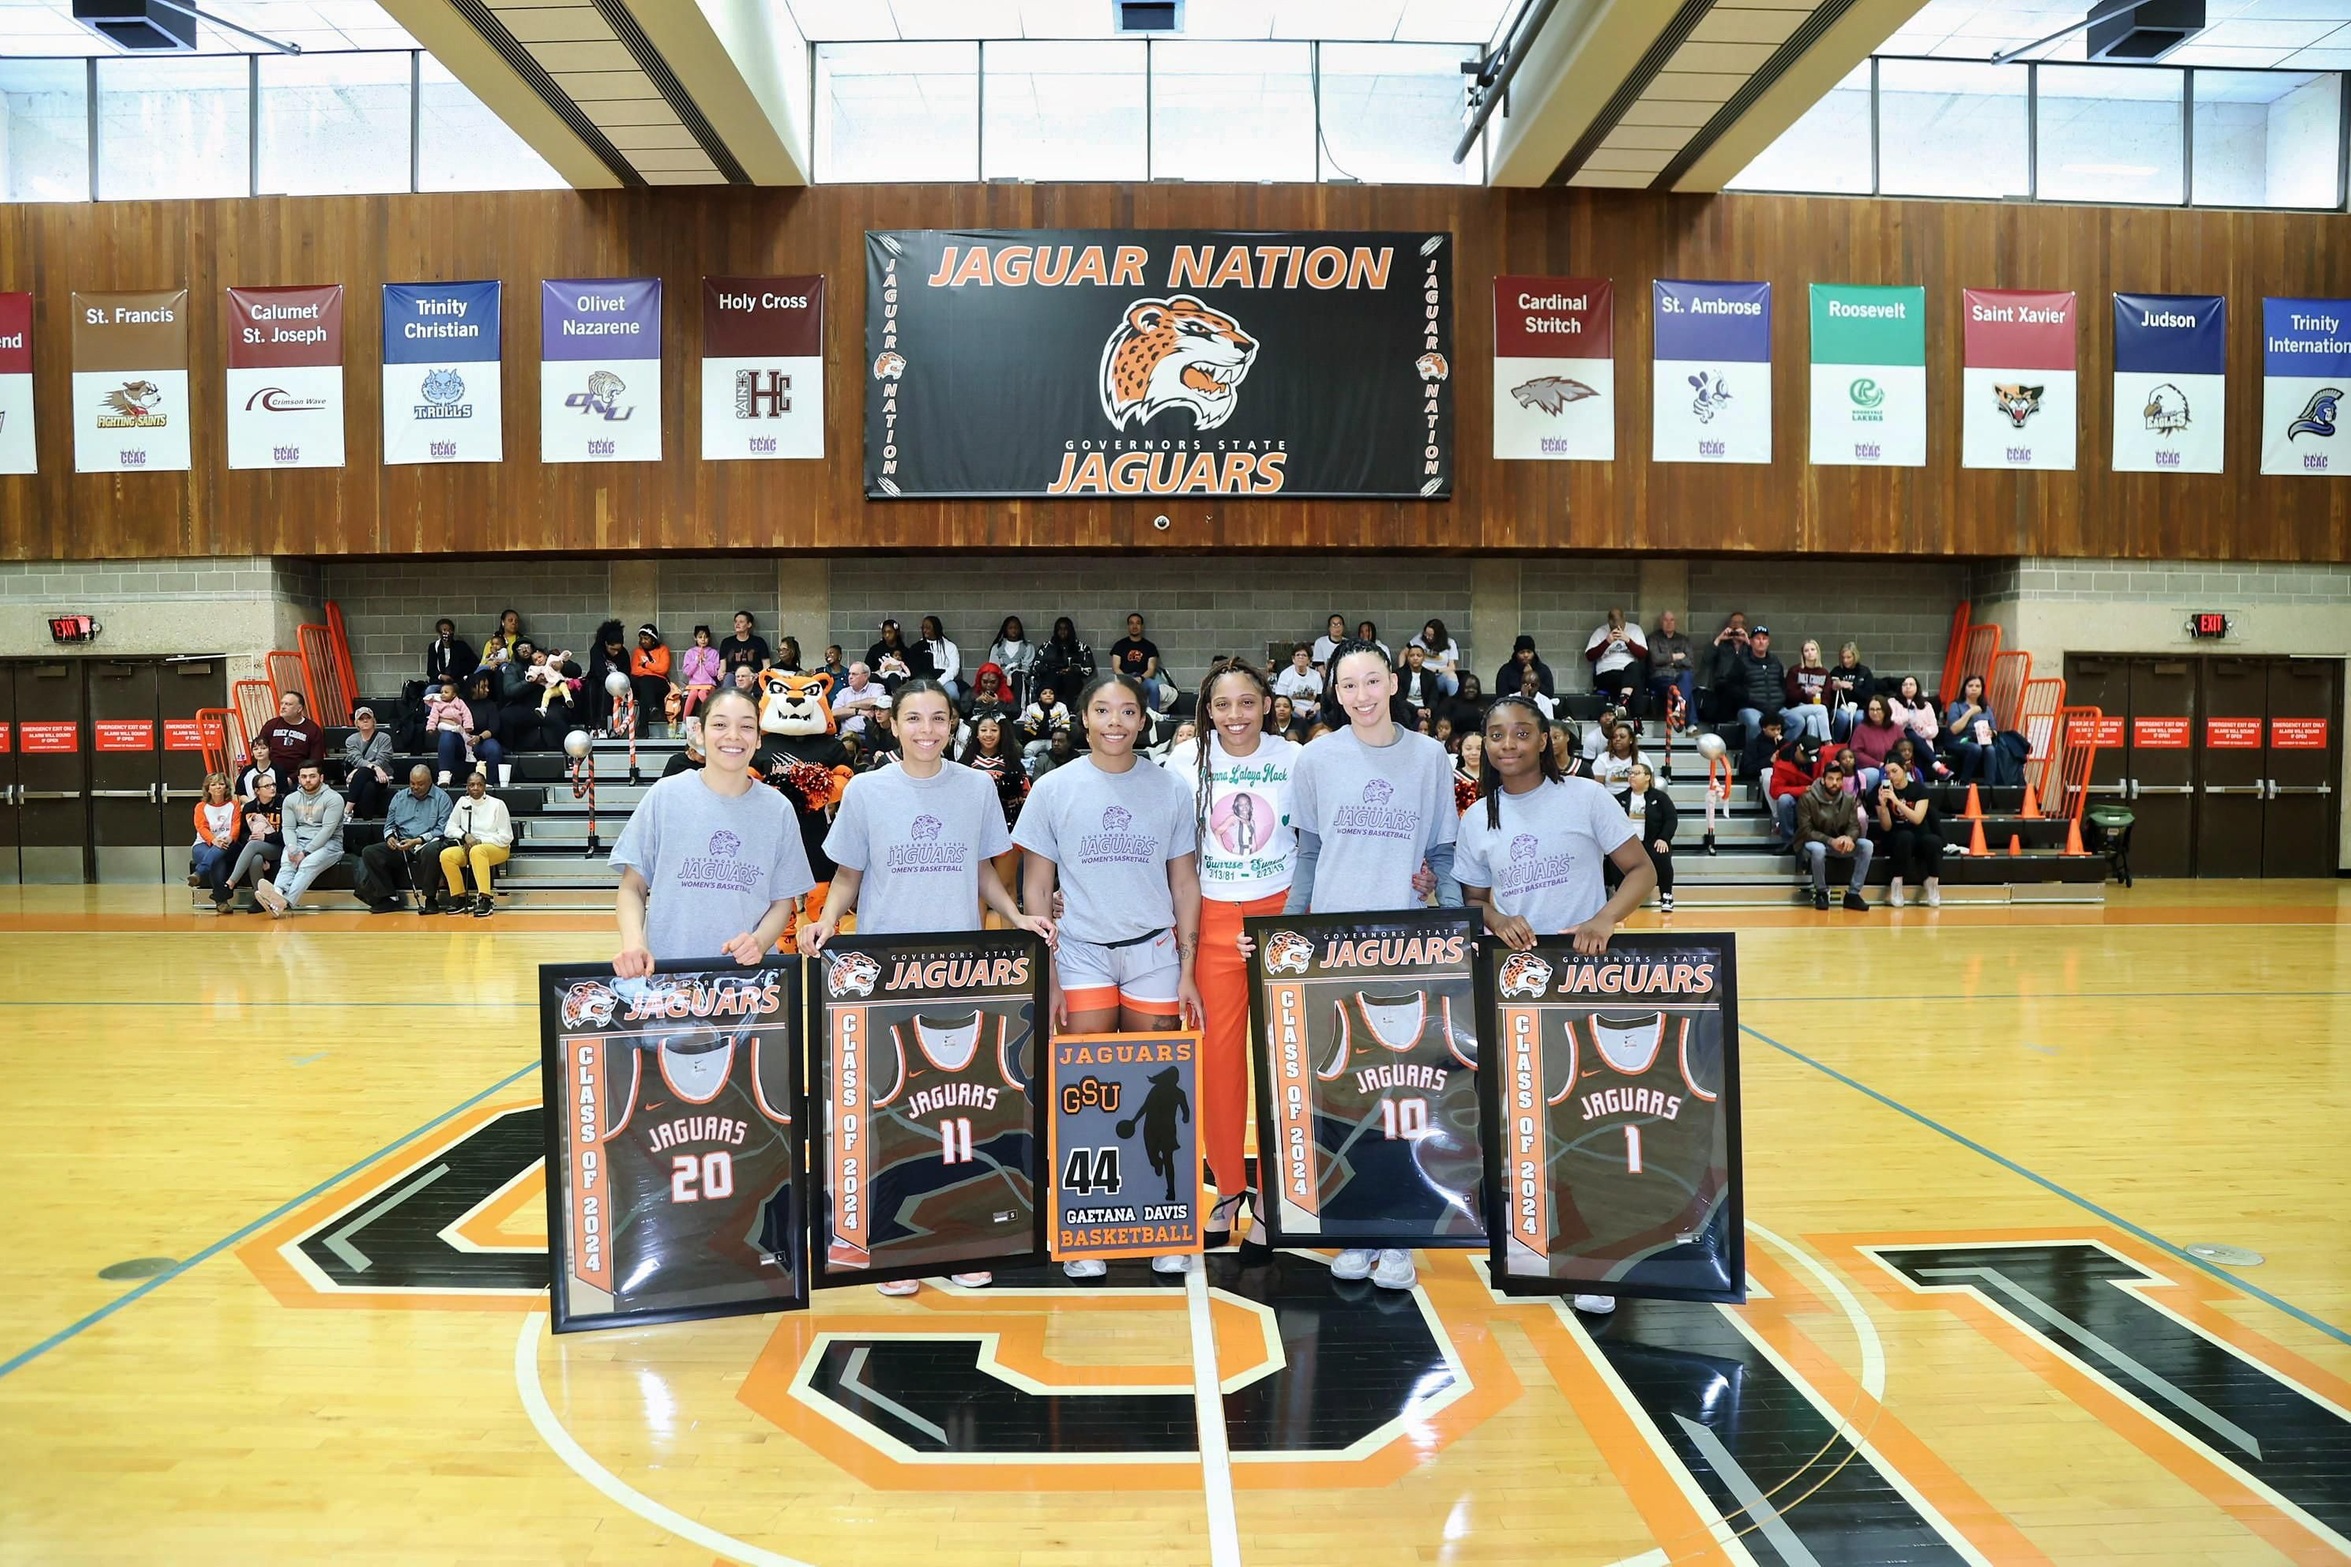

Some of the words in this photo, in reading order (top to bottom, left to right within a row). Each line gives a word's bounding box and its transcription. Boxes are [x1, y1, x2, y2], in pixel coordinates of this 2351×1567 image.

[928, 246, 1149, 287] JAGUAR
[1167, 245, 1394, 290] NATION
[251, 303, 318, 320] Calumet
[416, 299, 467, 317] Trinity
[577, 295, 625, 312] Olivet
[719, 293, 757, 313] Holy
[762, 293, 807, 309] Cross
[883, 259, 897, 349] JAGUAR
[1424, 259, 1439, 349] JAGUAR
[1518, 293, 1587, 311] Cardinal
[1662, 296, 1684, 313] St.
[1690, 298, 1761, 315] Ambrose
[1829, 301, 1905, 319] Roosevelt
[86, 308, 109, 324] St.
[115, 307, 173, 323] Francis
[1972, 305, 2013, 322] Saint
[2019, 306, 2065, 324] Xavier
[2141, 311, 2196, 328] Judson
[2291, 314, 2339, 333] Trinity
[243, 327, 265, 344] St.
[271, 326, 327, 345] Joseph
[404, 323, 479, 339] Christian
[563, 320, 640, 336] Nazarene
[1525, 317, 1581, 334] Stritch
[414, 404, 472, 419] TROLLS
[565, 393, 637, 421] ONU
[97, 415, 136, 428] FIGHTING
[138, 414, 167, 427] SAINTS
[882, 384, 897, 474] NATION
[1424, 384, 1439, 475] NATION
[273, 447, 299, 460] CCAC
[430, 443, 456, 456] CCAC
[588, 441, 614, 454] CCAC
[750, 438, 776, 452] CCAC
[1065, 440, 1201, 451] GOVERNORS
[1219, 440, 1286, 451] STATE
[1542, 439, 1567, 452] CCAC
[1699, 442, 1725, 454] CCAC
[1855, 445, 1881, 457] CCAC
[2007, 448, 2031, 461] CCAC
[120, 452, 146, 464] CCAC
[2156, 452, 2180, 464] CCAC
[2304, 455, 2328, 468] CCAC
[1047, 452, 1287, 494] JAGUARS
[2201, 615, 2222, 632] EXIT
[1334, 810, 1416, 831] JAGUARS
[1368, 829, 1411, 840] BASKETBALL
[887, 847, 964, 866] JAGUARS
[1079, 838, 1155, 856] JAGUARS
[892, 865, 918, 873] OMEN'S
[1082, 856, 1113, 864] WOMEN'S
[678, 861, 759, 885] JAGUARS
[1525, 877, 1569, 893] BASKETBALL
[1324, 931, 1405, 940] GOVERNORS
[891, 952, 973, 960] GOVERNORS
[1320, 937, 1464, 968] JAGUARS
[885, 958, 1030, 990] JAGUARS
[1558, 964, 1714, 993] JAGUARS
[624, 985, 781, 1021] JAGUARS
[1281, 990, 1300, 1078] CLASS
[842, 1014, 858, 1107] CLASS
[1059, 1044, 1192, 1065] JAGUARS
[1515, 1015, 1533, 1109] CLASS
[1356, 1064, 1448, 1095] JAGUARS
[578, 1046, 597, 1143] CLASS
[908, 1083, 999, 1119] JAGUARS
[1062, 1075, 1121, 1114] GSU
[1287, 1086, 1302, 1120] OF
[1581, 1087, 1682, 1121] JAGUARS
[1381, 1098, 1428, 1141] 10
[649, 1116, 747, 1152] JAGUARS
[843, 1114, 858, 1150] OF
[939, 1117, 972, 1165] 11
[1519, 1117, 1534, 1154] OF
[1624, 1124, 1643, 1174] 1
[581, 1151, 598, 1190] OF
[1063, 1146, 1122, 1196] 44
[1290, 1127, 1307, 1195] 2024
[671, 1151, 734, 1203] 20
[843, 1158, 858, 1230] 2024
[1521, 1162, 1537, 1235] 2024
[1066, 1207, 1136, 1224] GAETANA
[1144, 1204, 1188, 1221] DAVIS
[583, 1196, 600, 1272] 2024
[1061, 1225, 1193, 1247] BASKETBALL
